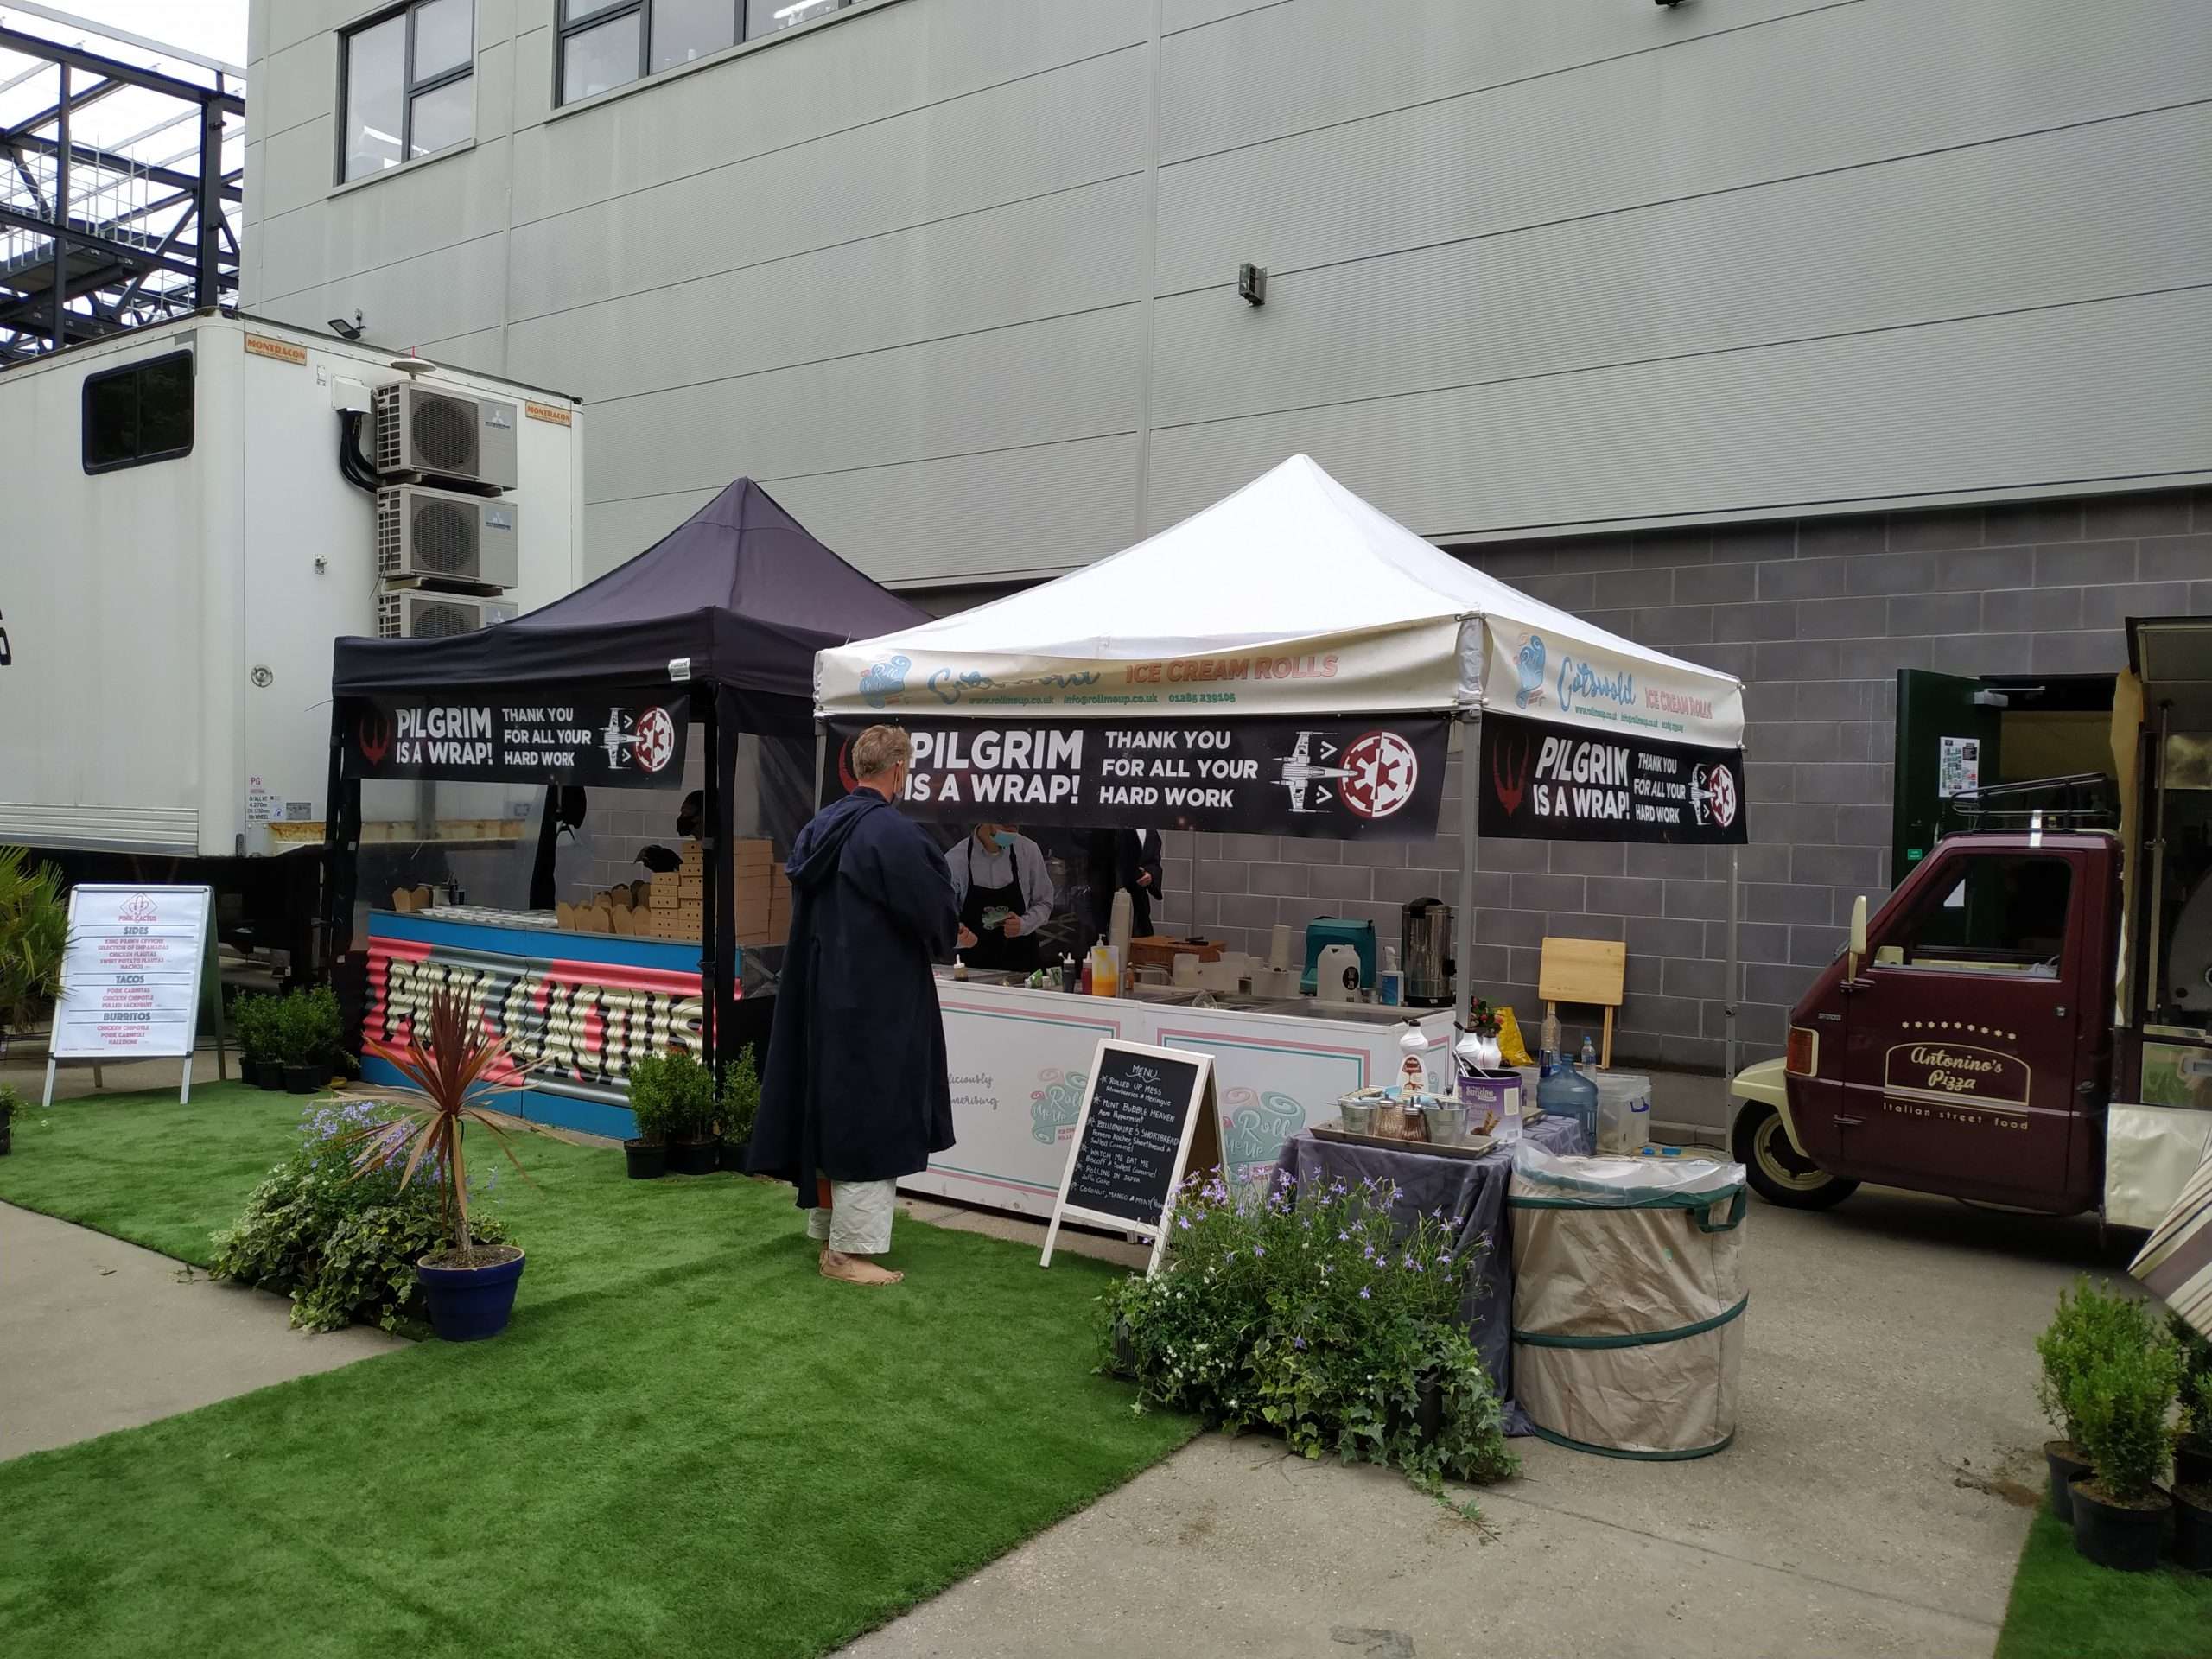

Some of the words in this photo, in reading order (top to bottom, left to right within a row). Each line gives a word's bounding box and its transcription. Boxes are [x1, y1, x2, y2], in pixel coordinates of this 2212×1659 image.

[1126, 663, 1162, 683] ICE
[1167, 658, 1250, 682] CREAM
[1254, 655, 1338, 680] ROLLS
[1557, 657, 1637, 711] Cotswold
[1644, 688, 1660, 710] ICE
[1660, 690, 1688, 715] CREAM
[1688, 696, 1713, 719] ROLLS
[395, 707, 492, 739] PILGRIM
[502, 708, 544, 722] THANK
[546, 707, 574, 722] YOU
[504, 728, 530, 744] FOR
[532, 728, 555, 744] ALL
[556, 728, 591, 746] YOUR
[1105, 730, 1178, 749] THANK
[1183, 730, 1231, 749] YOU
[396, 742, 409, 763] IS
[411, 742, 422, 764] A
[427, 741, 493, 765] WRAP!
[505, 751, 538, 766] HARD
[540, 751, 575, 766] WORK
[910, 729, 1084, 770] PILGRIM
[1102, 758, 1143, 777] FOR
[1149, 759, 1191, 778] ALL
[1197, 760, 1259, 779] YOUR
[1535, 736, 1630, 787] PILGRIM
[1637, 753, 1662, 772] THANK
[1662, 756, 1678, 775] YOU
[904, 773, 931, 801] IS
[938, 774, 961, 802] A
[970, 773, 1080, 804] WRAP!
[1099, 786, 1159, 805] HARD
[1164, 787, 1235, 808] WORK
[1633, 778, 1650, 796] FOR
[1650, 781, 1666, 798] ALL
[1666, 782, 1686, 800] YOUR
[1533, 784, 1550, 816] IS
[1555, 786, 1569, 817] A
[1572, 787, 1630, 820] WRAP!
[1635, 804, 1656, 822] HARD
[1656, 805, 1680, 823] WORK
[124, 926, 149, 935] SIDES
[116, 975, 145, 984] TACOS
[104, 1012, 151, 1021] BURRITOS
[1910, 1046, 2003, 1073] Antonino's
[1132, 1065, 1159, 1079] MENU
[1928, 1069, 1978, 1091] Pizza
[1109, 1077, 1130, 1089] ROLLED
[1145, 1085, 1162, 1096] MESS
[1103, 1099, 1119, 1109] MINT
[1150, 1109, 1175, 1123] HEAVEN
[1145, 1094, 1172, 1109] Meringue
[1112, 1111, 1144, 1124] Peppermint
[1238, 1110, 1291, 1142] Roll
[1883, 1103, 1930, 1117] Italian
[1940, 1110, 1982, 1123] street
[1994, 1117, 2028, 1130] food
[1141, 1128, 1179, 1146] SHORTBREAD
[1090, 1148, 1111, 1159] WATCH
[1126, 1156, 1138, 1166] EAT
[1140, 1160, 1149, 1168] ME
[1085, 1165, 1110, 1177] ROLLING
[1108, 1192, 1128, 1201] MANGO
